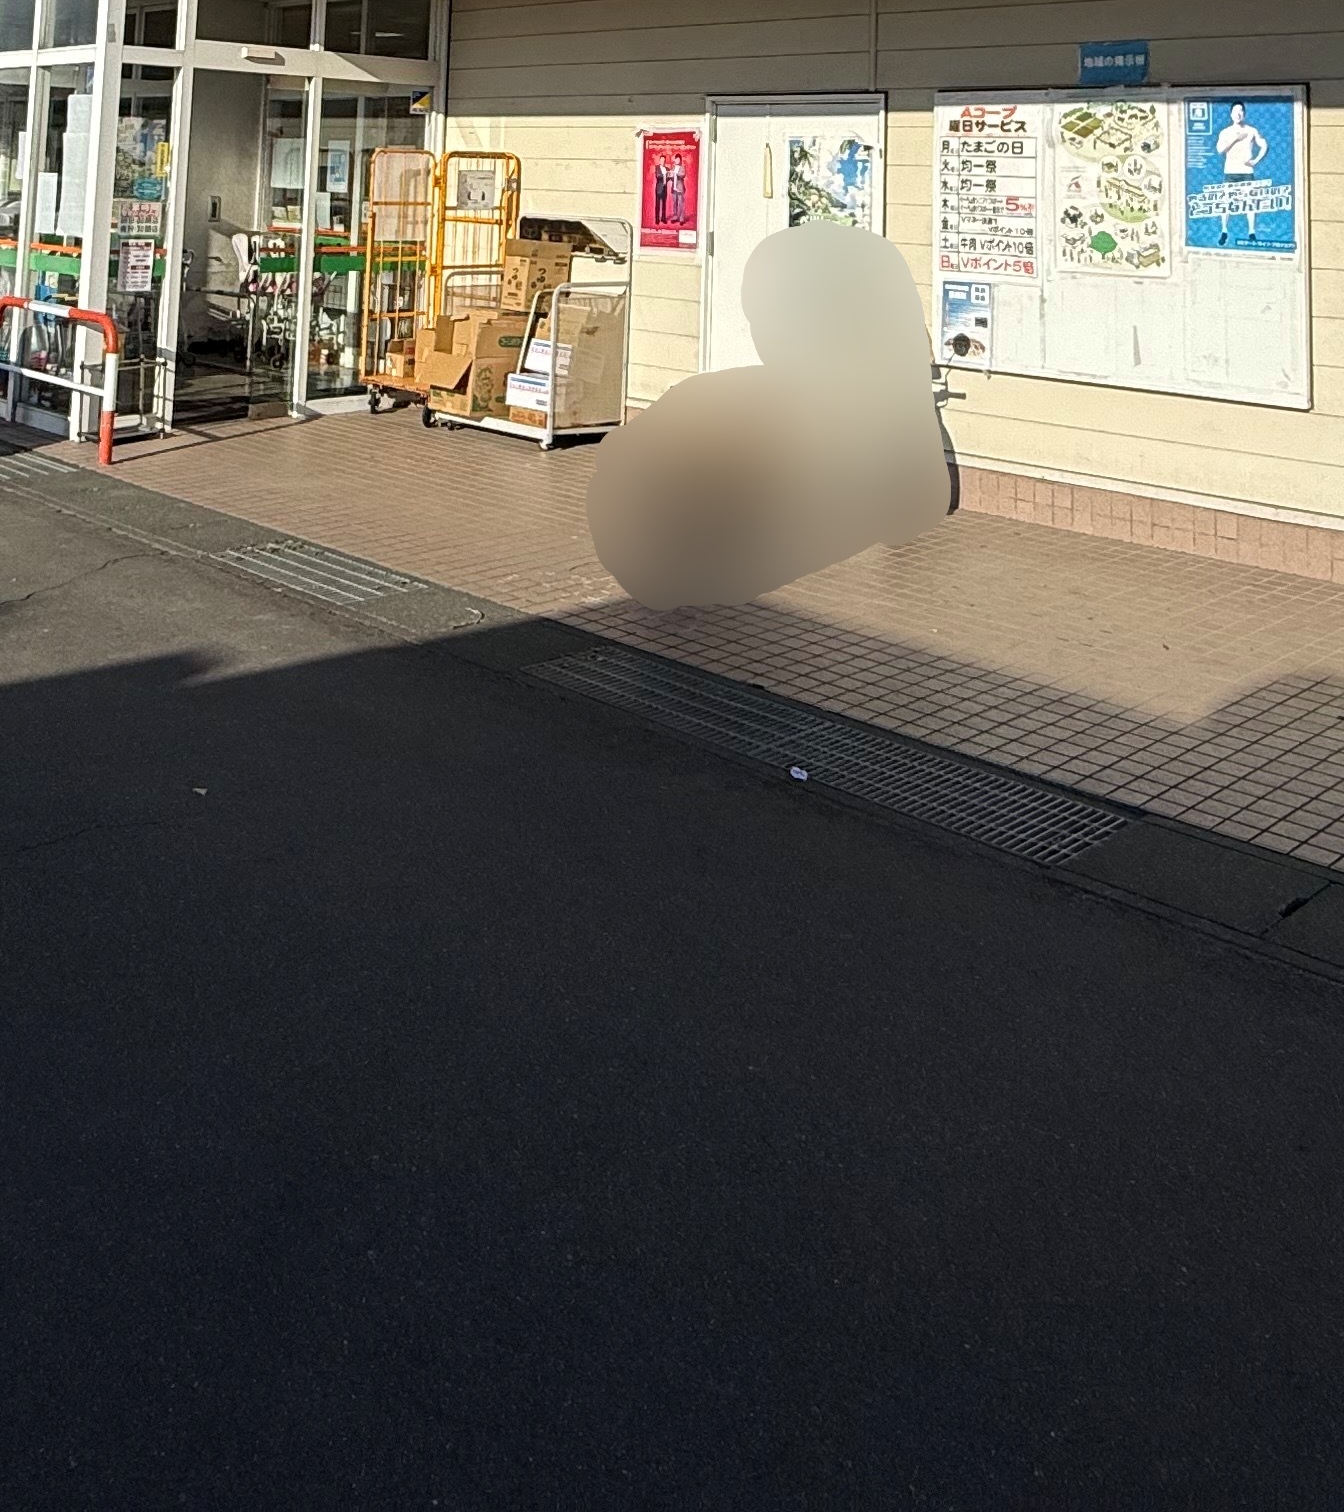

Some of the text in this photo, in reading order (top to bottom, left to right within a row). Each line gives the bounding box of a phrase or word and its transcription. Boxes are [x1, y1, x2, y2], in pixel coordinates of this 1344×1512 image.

[960, 105, 1017, 120] Aコープ
[949, 120, 1027, 133] 曜日サービス
[960, 140, 1024, 155] たまごの日
